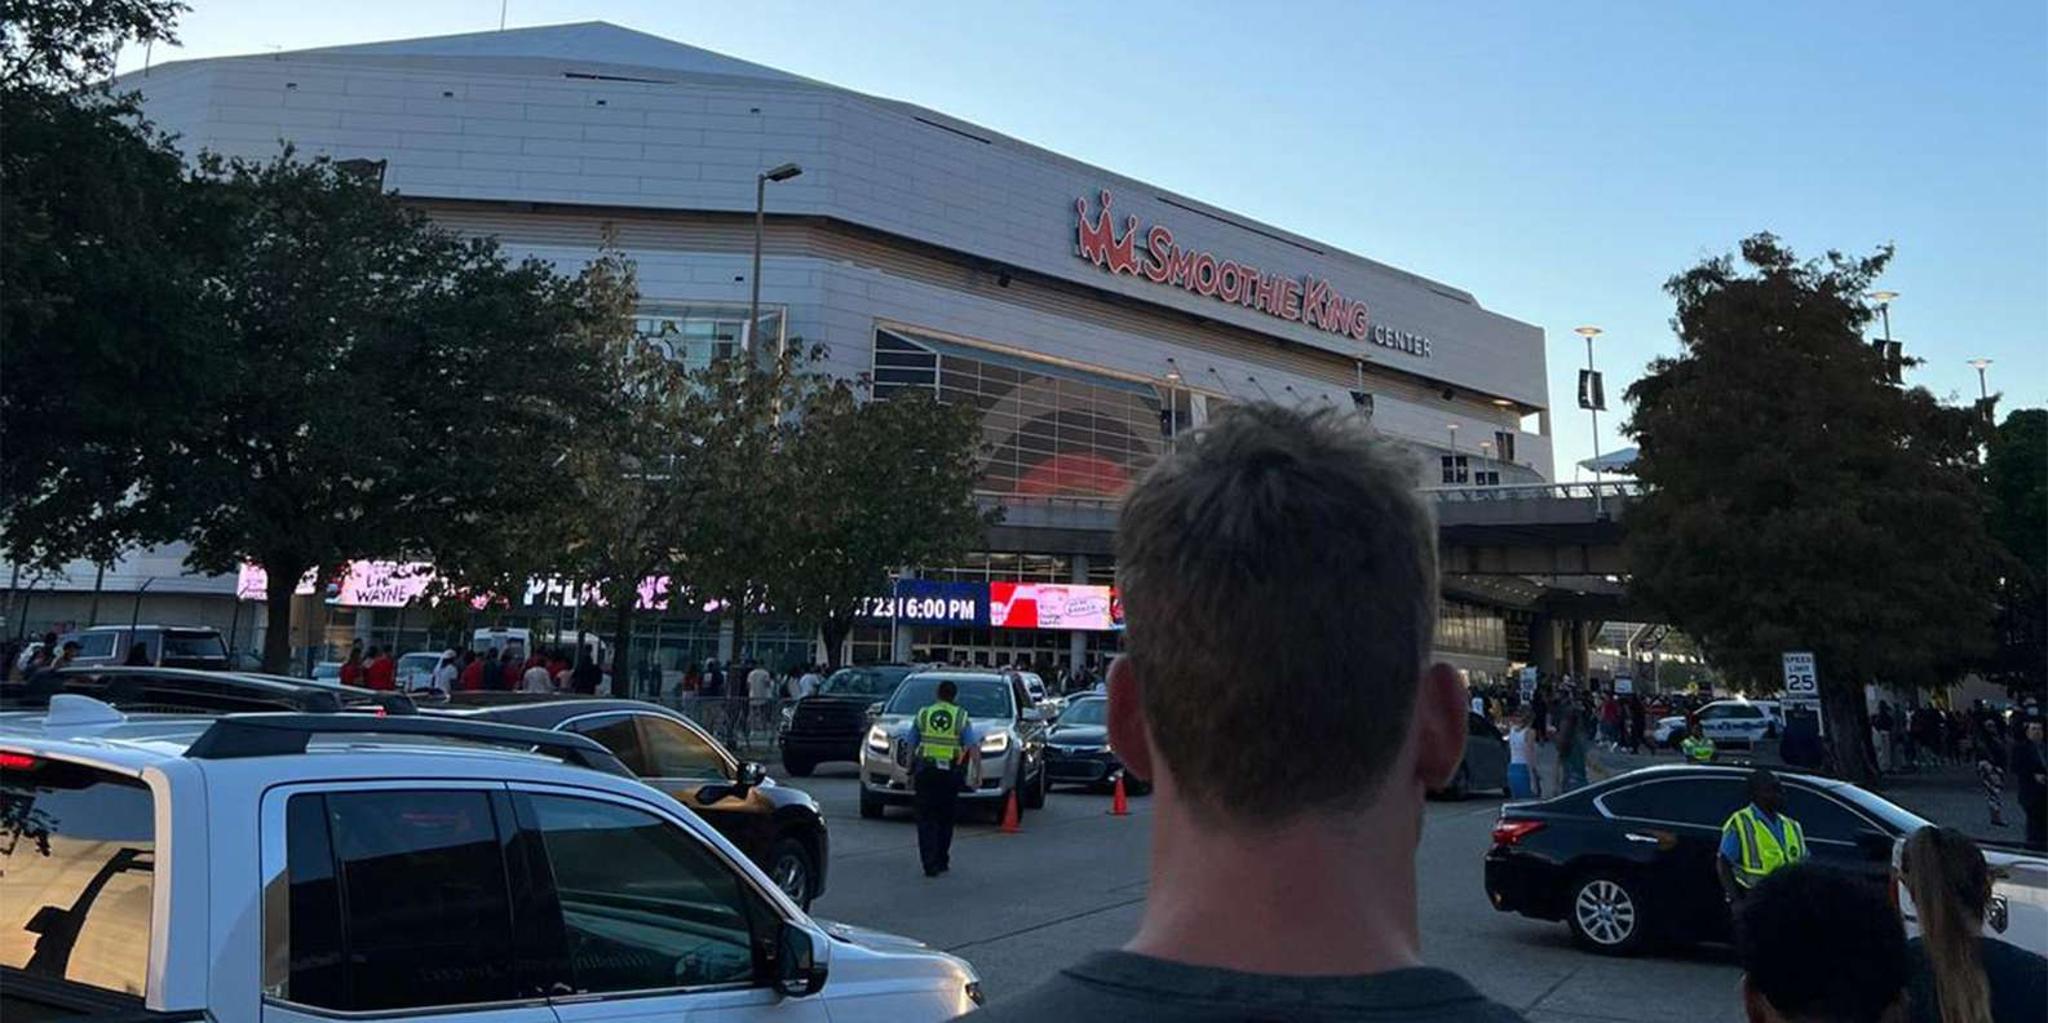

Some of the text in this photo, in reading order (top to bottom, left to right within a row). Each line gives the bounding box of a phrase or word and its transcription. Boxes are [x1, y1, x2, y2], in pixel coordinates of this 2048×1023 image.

[1144, 225, 1300, 321] SMOOTHIE
[1374, 325, 1433, 359] CENTER
[355, 585, 407, 603] WAYNE
[873, 597, 895, 617] 23
[906, 598, 946, 619] 6:00
[948, 599, 975, 620] PM
[1785, 656, 1812, 664] SPEED
[1788, 665, 1811, 673] LIMIT
[1788, 675, 1814, 691] 25
